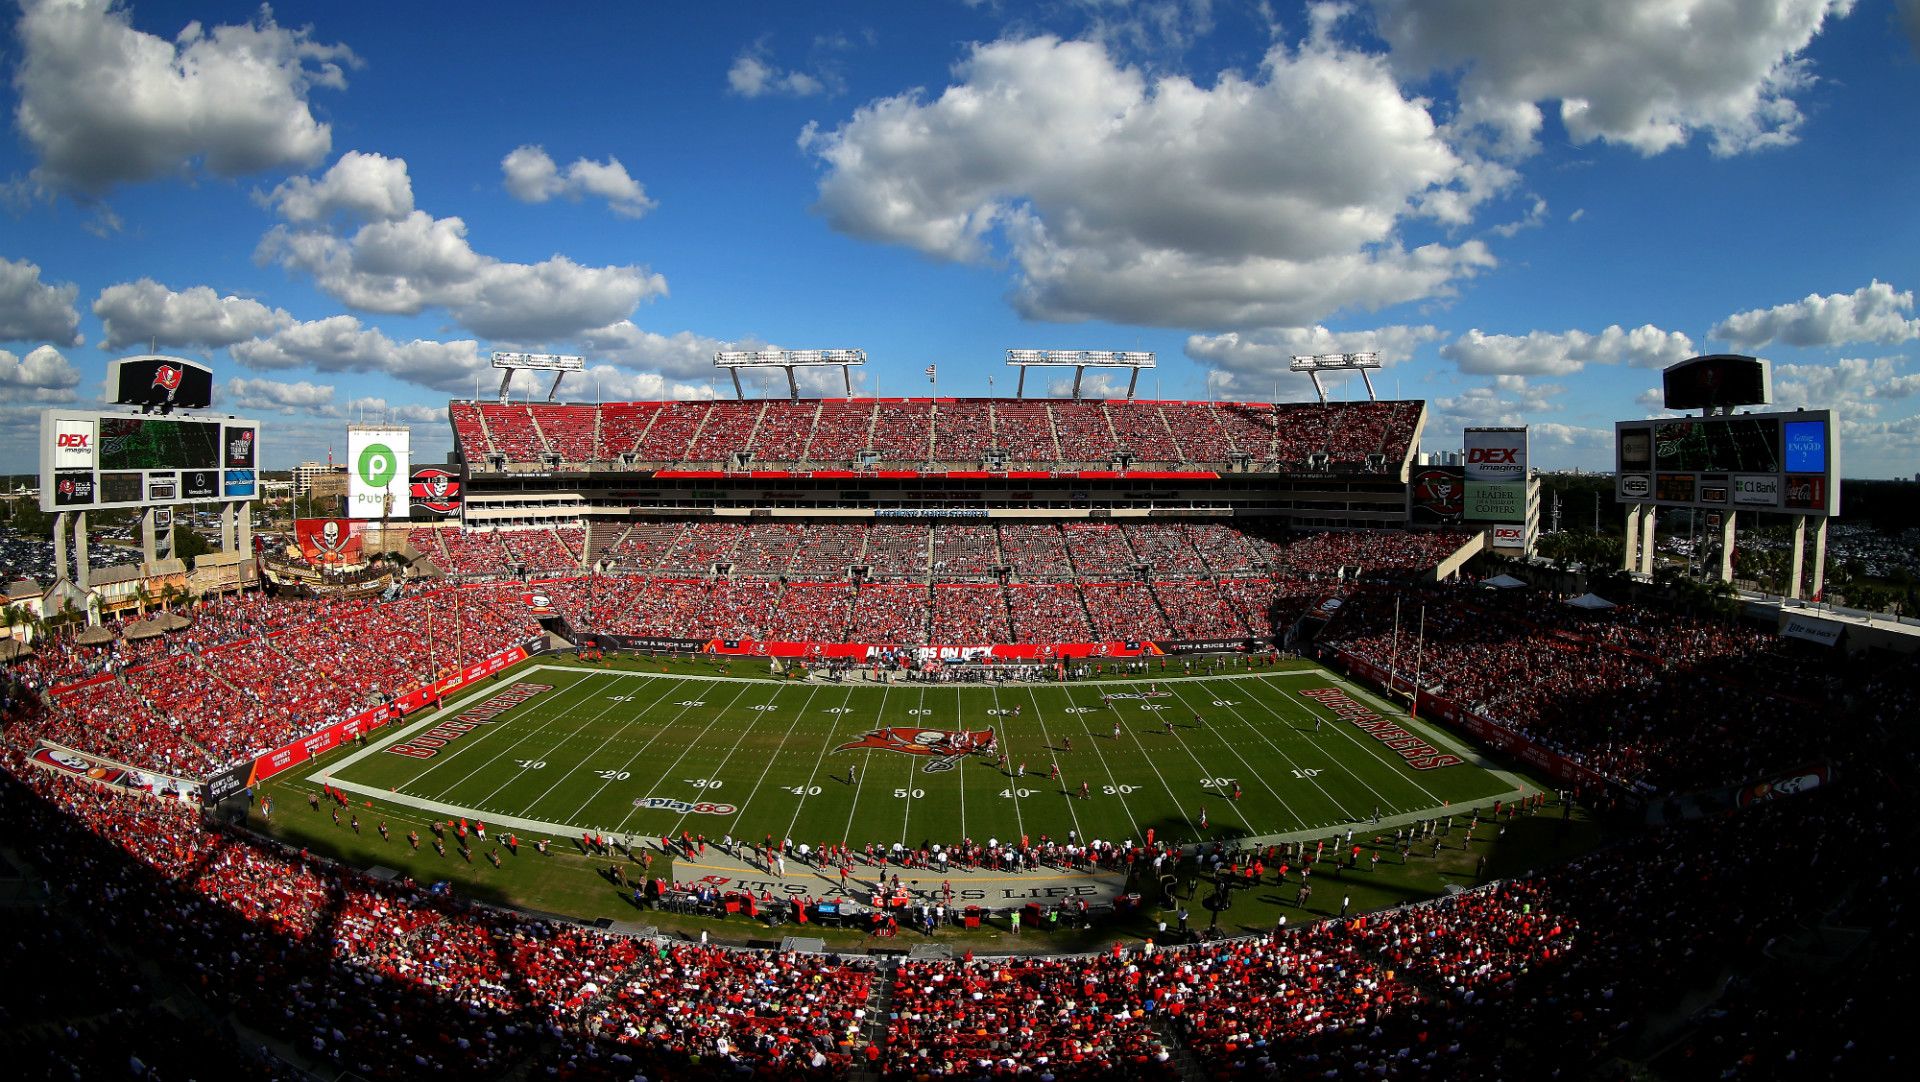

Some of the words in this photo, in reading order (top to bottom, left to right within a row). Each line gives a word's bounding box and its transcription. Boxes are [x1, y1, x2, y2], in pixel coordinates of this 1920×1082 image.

[57, 433, 89, 447] DEX
[1467, 447, 1519, 464] DEX
[1479, 464, 1524, 472] imaging
[1624, 480, 1648, 491] HESS
[1744, 481, 1755, 493] C1
[1756, 481, 1777, 493] Bank
[358, 493, 397, 504] Pubx
[1476, 490, 1514, 499] LEADER
[1475, 504, 1515, 513] COPIERS
[1495, 528, 1521, 537] DEX
[940, 646, 960, 659] ON
[1297, 687, 1465, 771] BUCCANEERS
[519, 759, 547, 769] 10
[599, 769, 631, 780] 20
[1291, 768, 1318, 779] 10
[692, 779, 723, 789] 30
[1200, 777, 1229, 788] 20
[791, 785, 822, 796] 40
[893, 788, 925, 799] 50
[999, 788, 1030, 798] 40
[1102, 784, 1133, 795] 30
[733, 879, 809, 896] IT'S
[821, 886, 851, 897] A
[1001, 885, 1099, 900] LIFE
